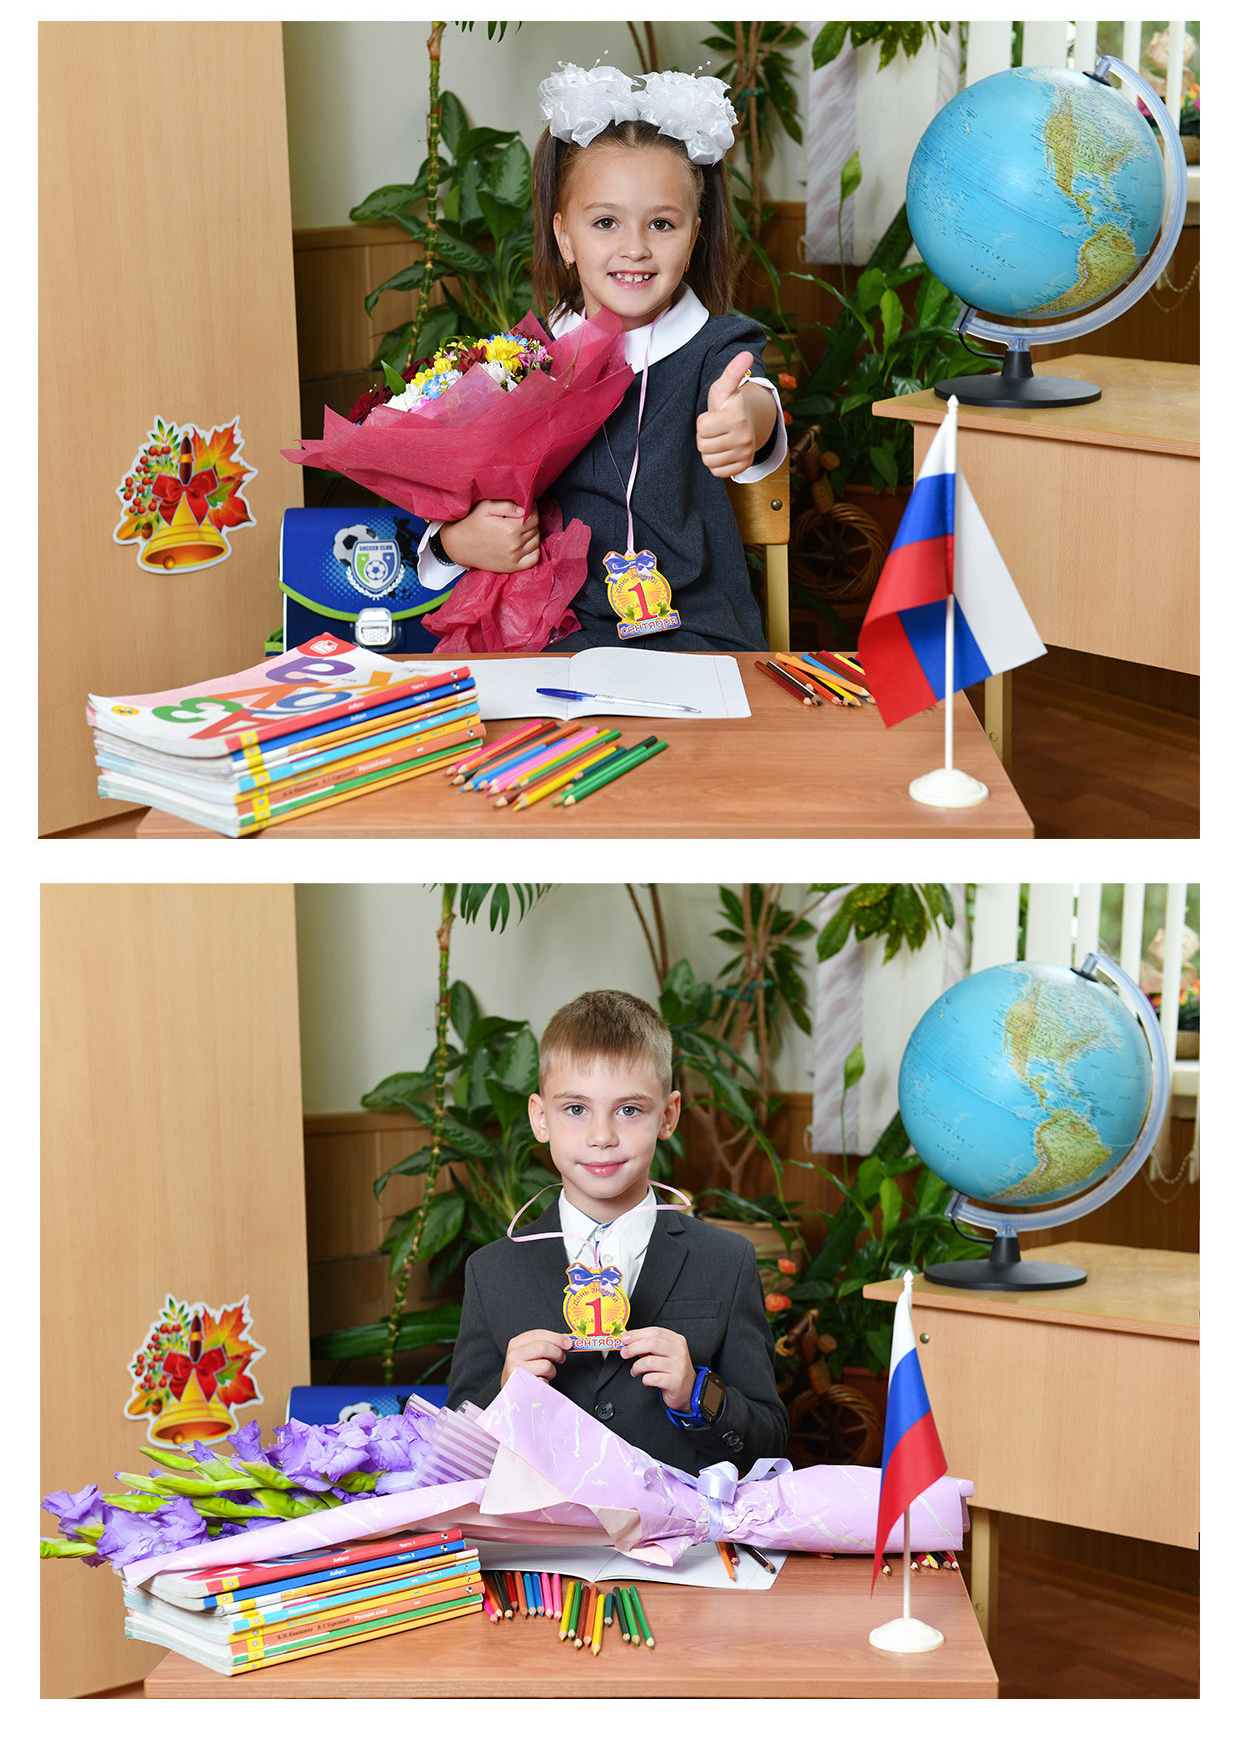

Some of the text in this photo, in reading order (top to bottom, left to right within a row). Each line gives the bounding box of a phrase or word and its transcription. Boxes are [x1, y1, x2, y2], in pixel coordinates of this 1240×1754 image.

[627, 582, 658, 622] 1
[621, 617, 678, 636] сентября
[585, 1297, 610, 1337] 1
